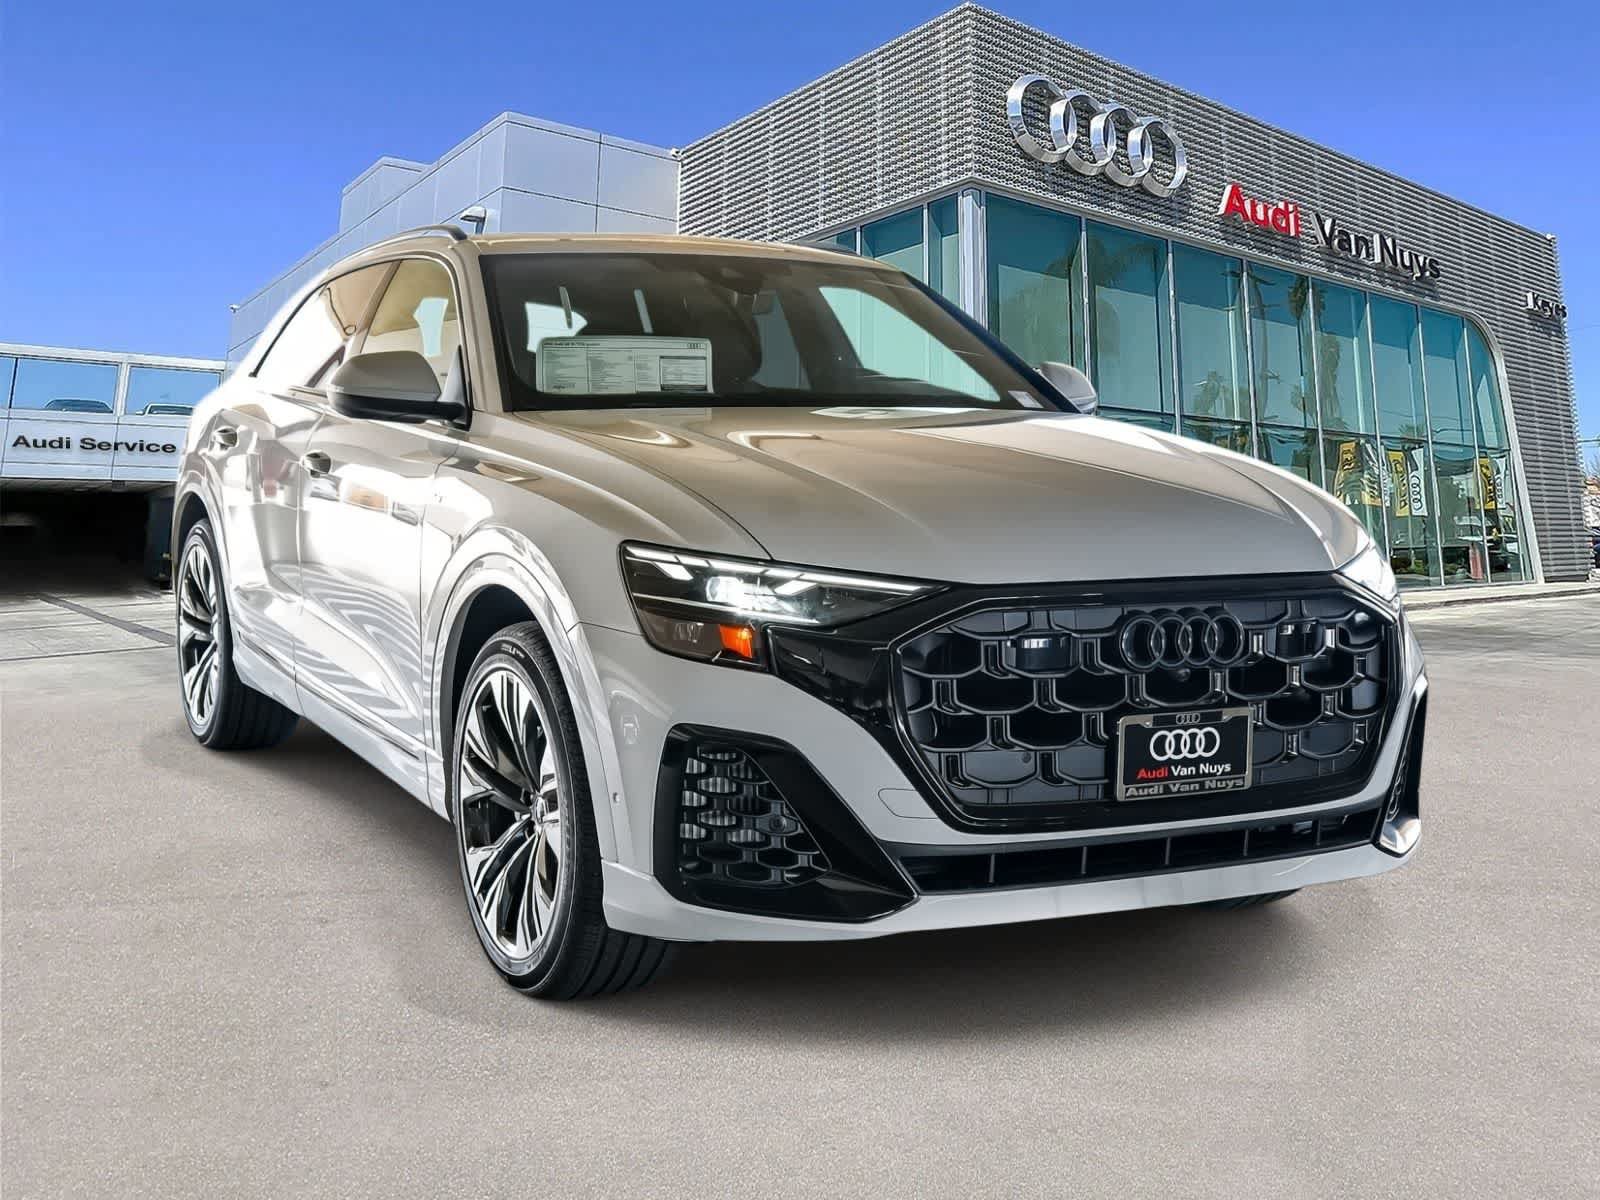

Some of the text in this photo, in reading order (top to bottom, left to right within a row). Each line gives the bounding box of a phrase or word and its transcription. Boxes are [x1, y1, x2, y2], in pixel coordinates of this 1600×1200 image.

[1219, 183, 1441, 280] Audi Van Nuys
[12, 435, 177, 453] Audi Service
[1136, 762, 1232, 779] Audi Van Nuys
[1126, 777, 1244, 797] Audi Van Nuys
